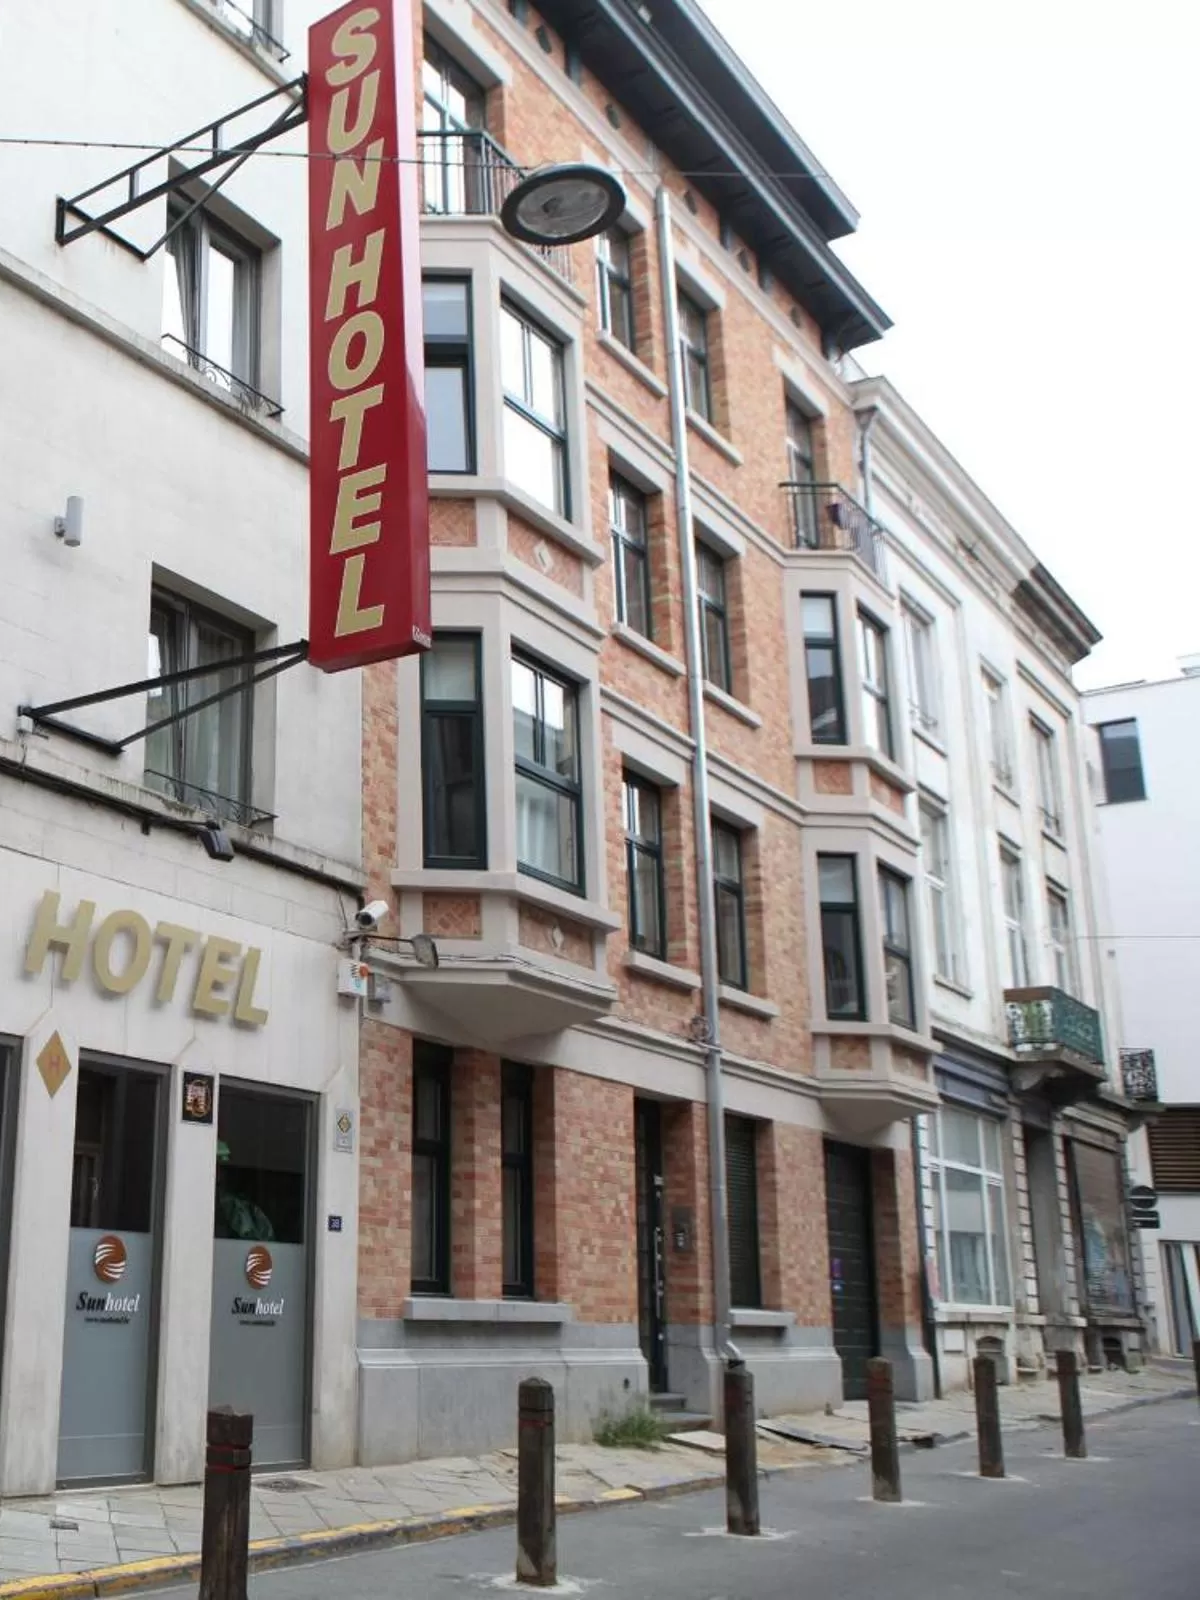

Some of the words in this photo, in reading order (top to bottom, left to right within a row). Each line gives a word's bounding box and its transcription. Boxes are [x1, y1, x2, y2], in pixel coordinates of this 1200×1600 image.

[24, 889, 269, 1027] HOTEL
[75, 1290, 141, 1312] Sunhotel
[231, 1296, 285, 1315] Sunhotel
